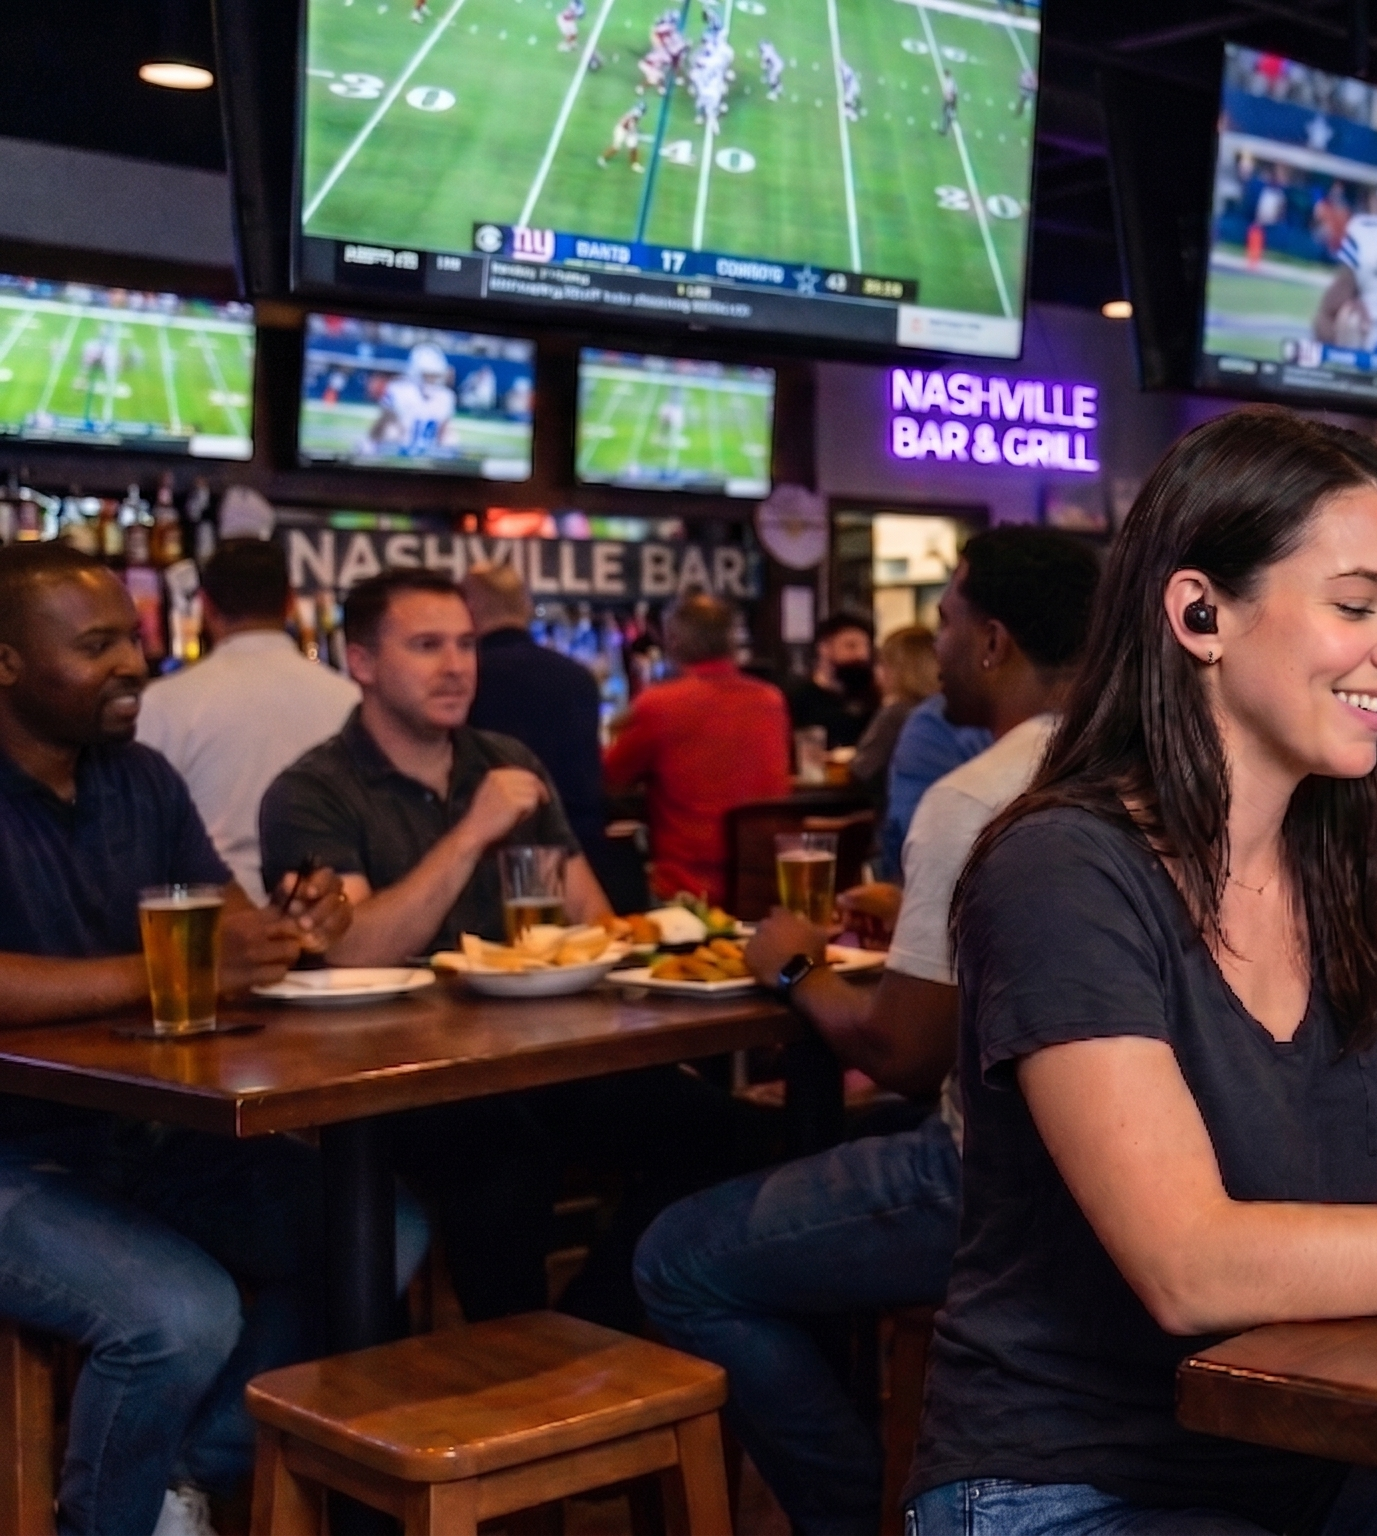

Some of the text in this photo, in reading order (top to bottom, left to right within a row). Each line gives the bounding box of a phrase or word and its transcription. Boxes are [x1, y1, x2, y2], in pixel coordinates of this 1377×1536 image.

[661, 250, 686, 274] 17
[892, 368, 1098, 428] NASHVILLE
[892, 416, 1100, 472] BAR & GRILL
